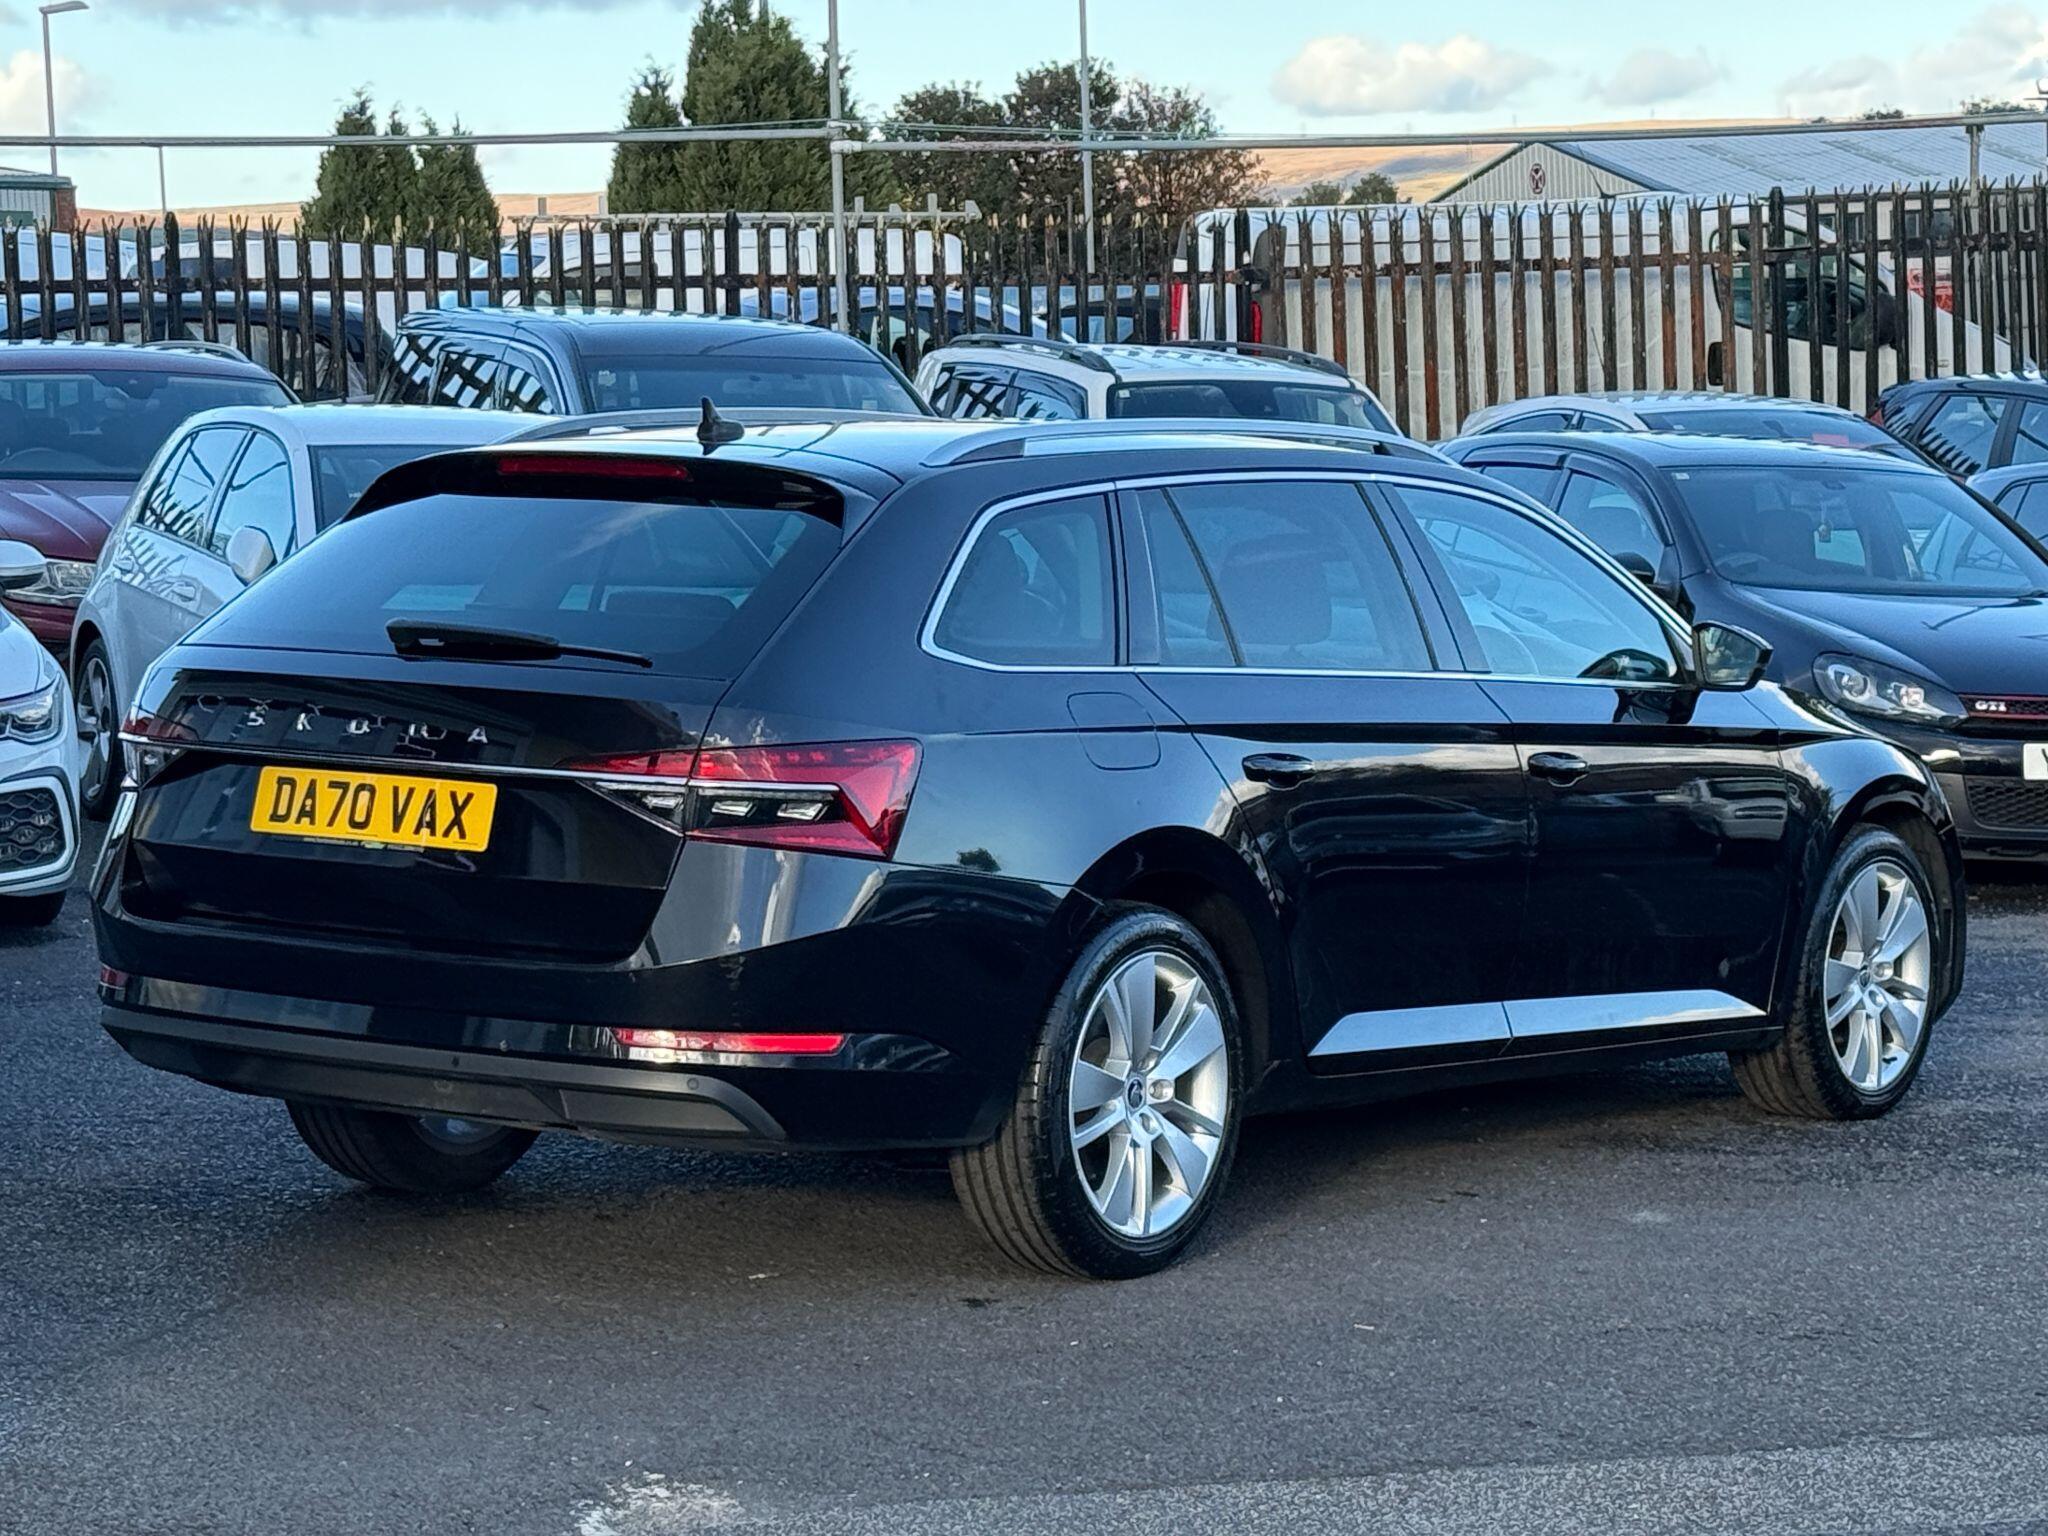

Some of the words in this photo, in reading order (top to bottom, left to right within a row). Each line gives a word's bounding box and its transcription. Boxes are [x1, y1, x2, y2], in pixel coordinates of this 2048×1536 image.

[1975, 700, 2007, 712] GTI
[269, 776, 377, 830] DA70
[392, 785, 475, 840] VAX
